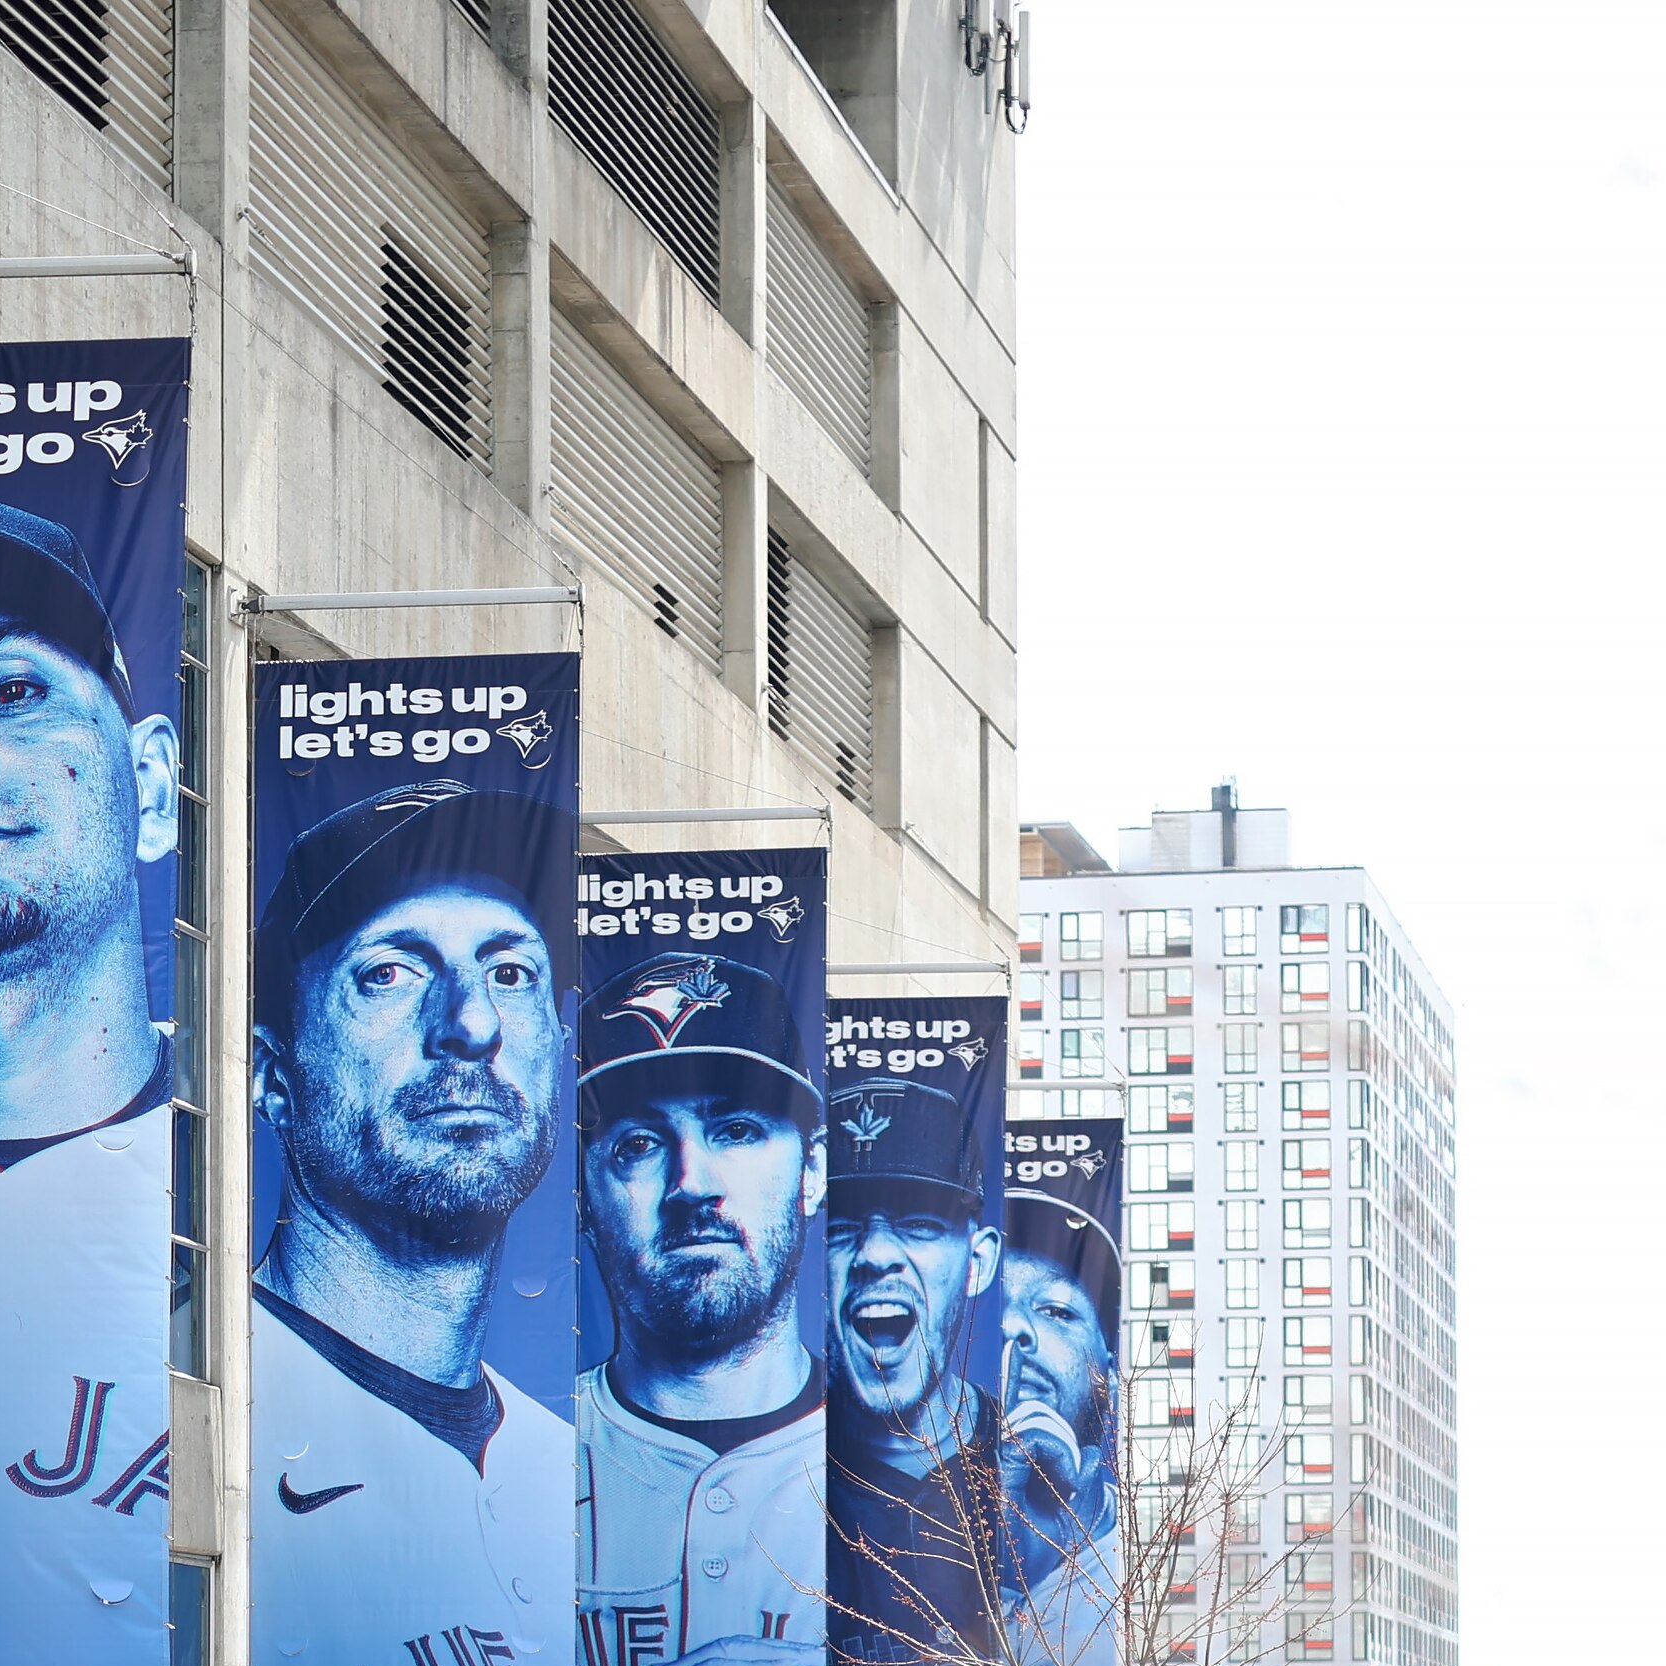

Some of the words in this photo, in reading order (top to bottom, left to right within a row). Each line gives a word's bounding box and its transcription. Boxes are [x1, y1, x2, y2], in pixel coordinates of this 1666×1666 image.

[28, 379, 123, 421] up
[279, 683, 443, 725] lights
[452, 685, 527, 719] up
[279, 724, 404, 759] let’s
[411, 728, 491, 763] go
[577, 873, 714, 908] lights
[720, 875, 783, 904] up
[687, 911, 753, 940] go
[825, 1015, 910, 1044] ghts
[916, 1020, 970, 1043] up
[887, 1048, 945, 1072] go
[1041, 1134, 1091, 1155] up
[1017, 1159, 1068, 1182] go
